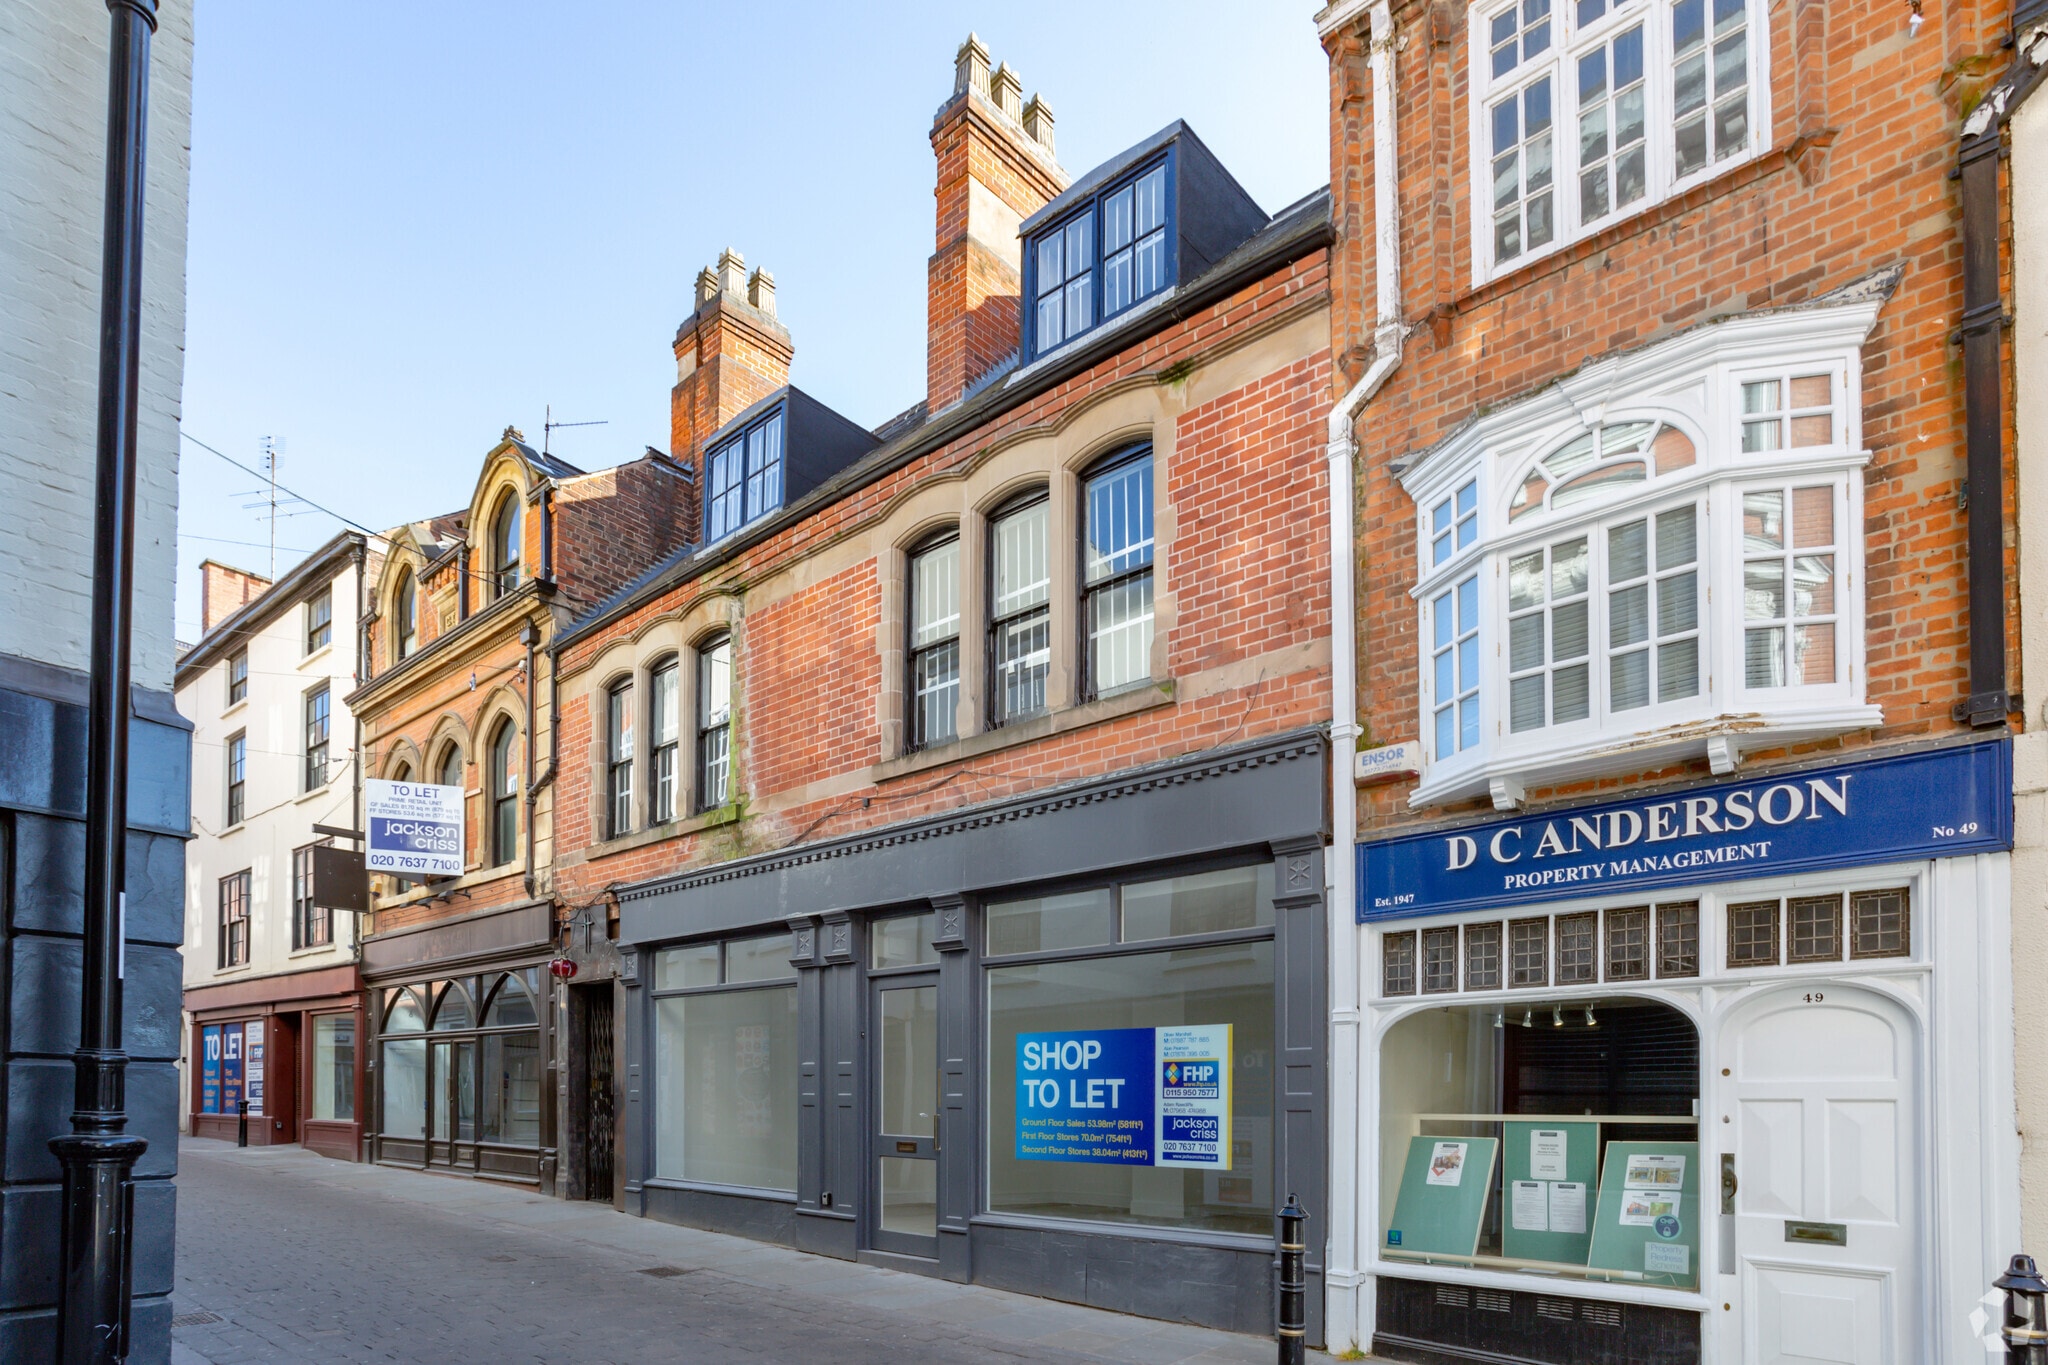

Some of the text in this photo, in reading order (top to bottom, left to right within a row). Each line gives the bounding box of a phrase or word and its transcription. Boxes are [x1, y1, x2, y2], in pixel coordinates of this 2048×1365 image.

[1362, 748, 1404, 766] ENSOR
[392, 785, 440, 799] TO LET
[384, 820, 457, 838] jackson
[1446, 775, 1851, 871] D C ANDERSON
[1932, 822, 1978, 838] No 49
[415, 837, 457, 850] criss
[371, 855, 460, 870] 020 7637 7100
[1504, 841, 1771, 889] PROPERTY MANAGEMENT
[1375, 894, 1414, 907] Est. 1947
[1803, 993, 1824, 1003] 49
[205, 1035, 220, 1060] TO
[224, 1033, 243, 1060] LET
[1023, 1040, 1101, 1071] SHOP
[1183, 1065, 1214, 1081] FHP
[1023, 1079, 1125, 1108] TO LET
[1021, 1118, 1046, 1127] Ground
[1048, 1119, 1065, 1127] Floor
[1066, 1119, 1085, 1128] Sales
[1172, 1117, 1217, 1130] jackson
[1022, 1132, 1036, 1140] First
[1038, 1132, 1055, 1140] Floor
[1057, 1132, 1079, 1141] Stores
[1190, 1128, 1217, 1139] criss
[1022, 1145, 1046, 1153] Second
[1048, 1146, 1065, 1154] Floor
[1067, 1147, 1090, 1156] Stores
[1164, 1142, 1216, 1152] 020 7637 7100
[1651, 1244, 1682, 1254] Property
